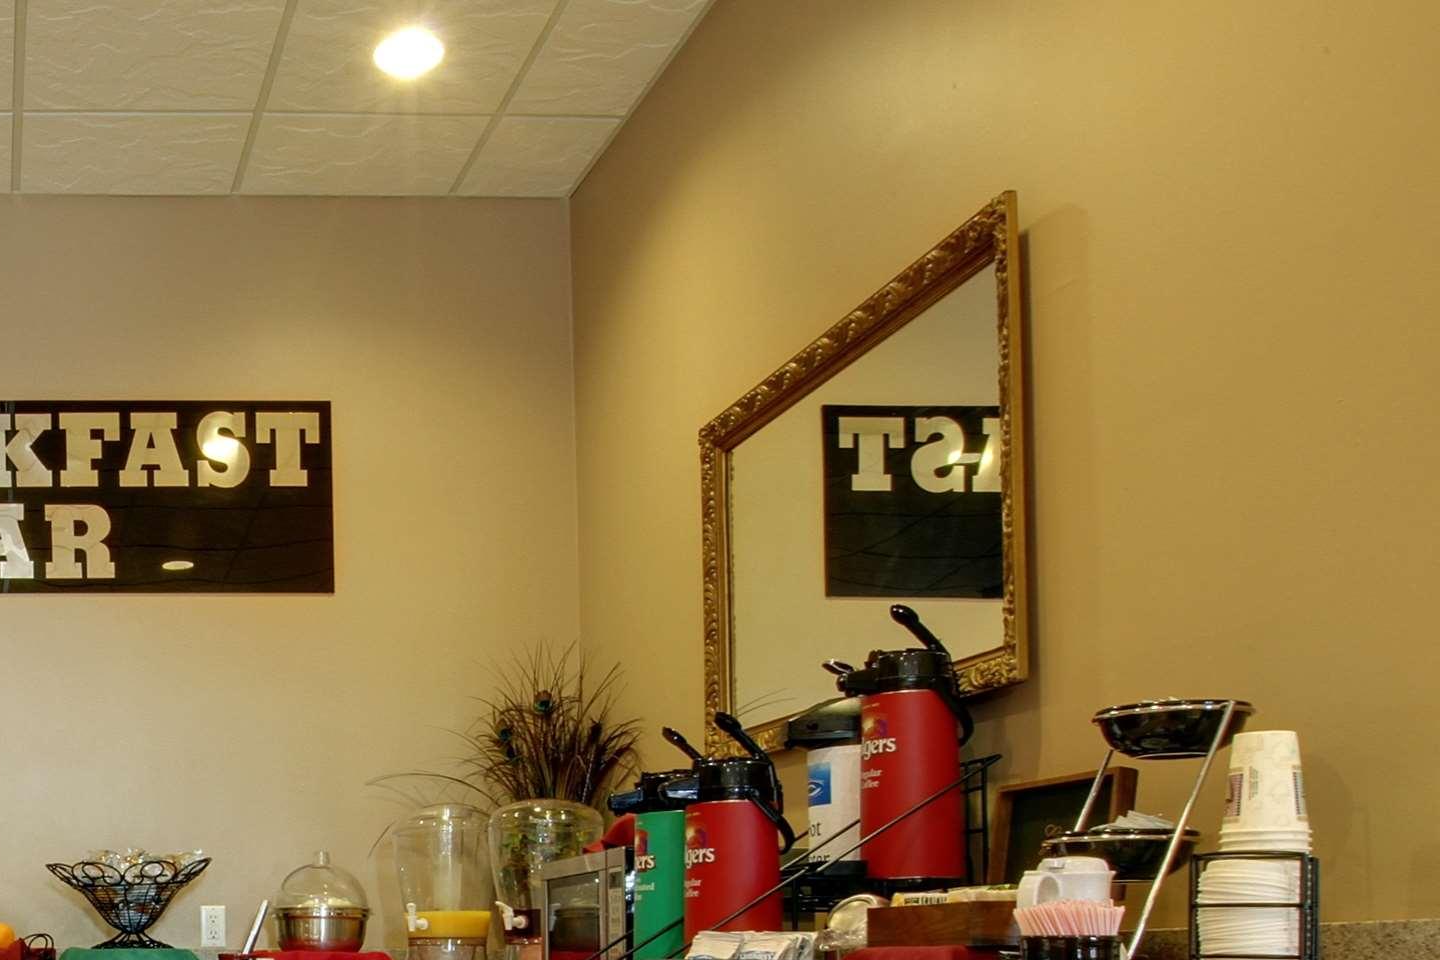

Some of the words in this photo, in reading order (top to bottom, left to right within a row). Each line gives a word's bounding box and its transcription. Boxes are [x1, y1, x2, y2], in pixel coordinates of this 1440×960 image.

[862, 737, 897, 760] gers
[635, 855, 655, 869] ers
[684, 845, 715, 870] gers
